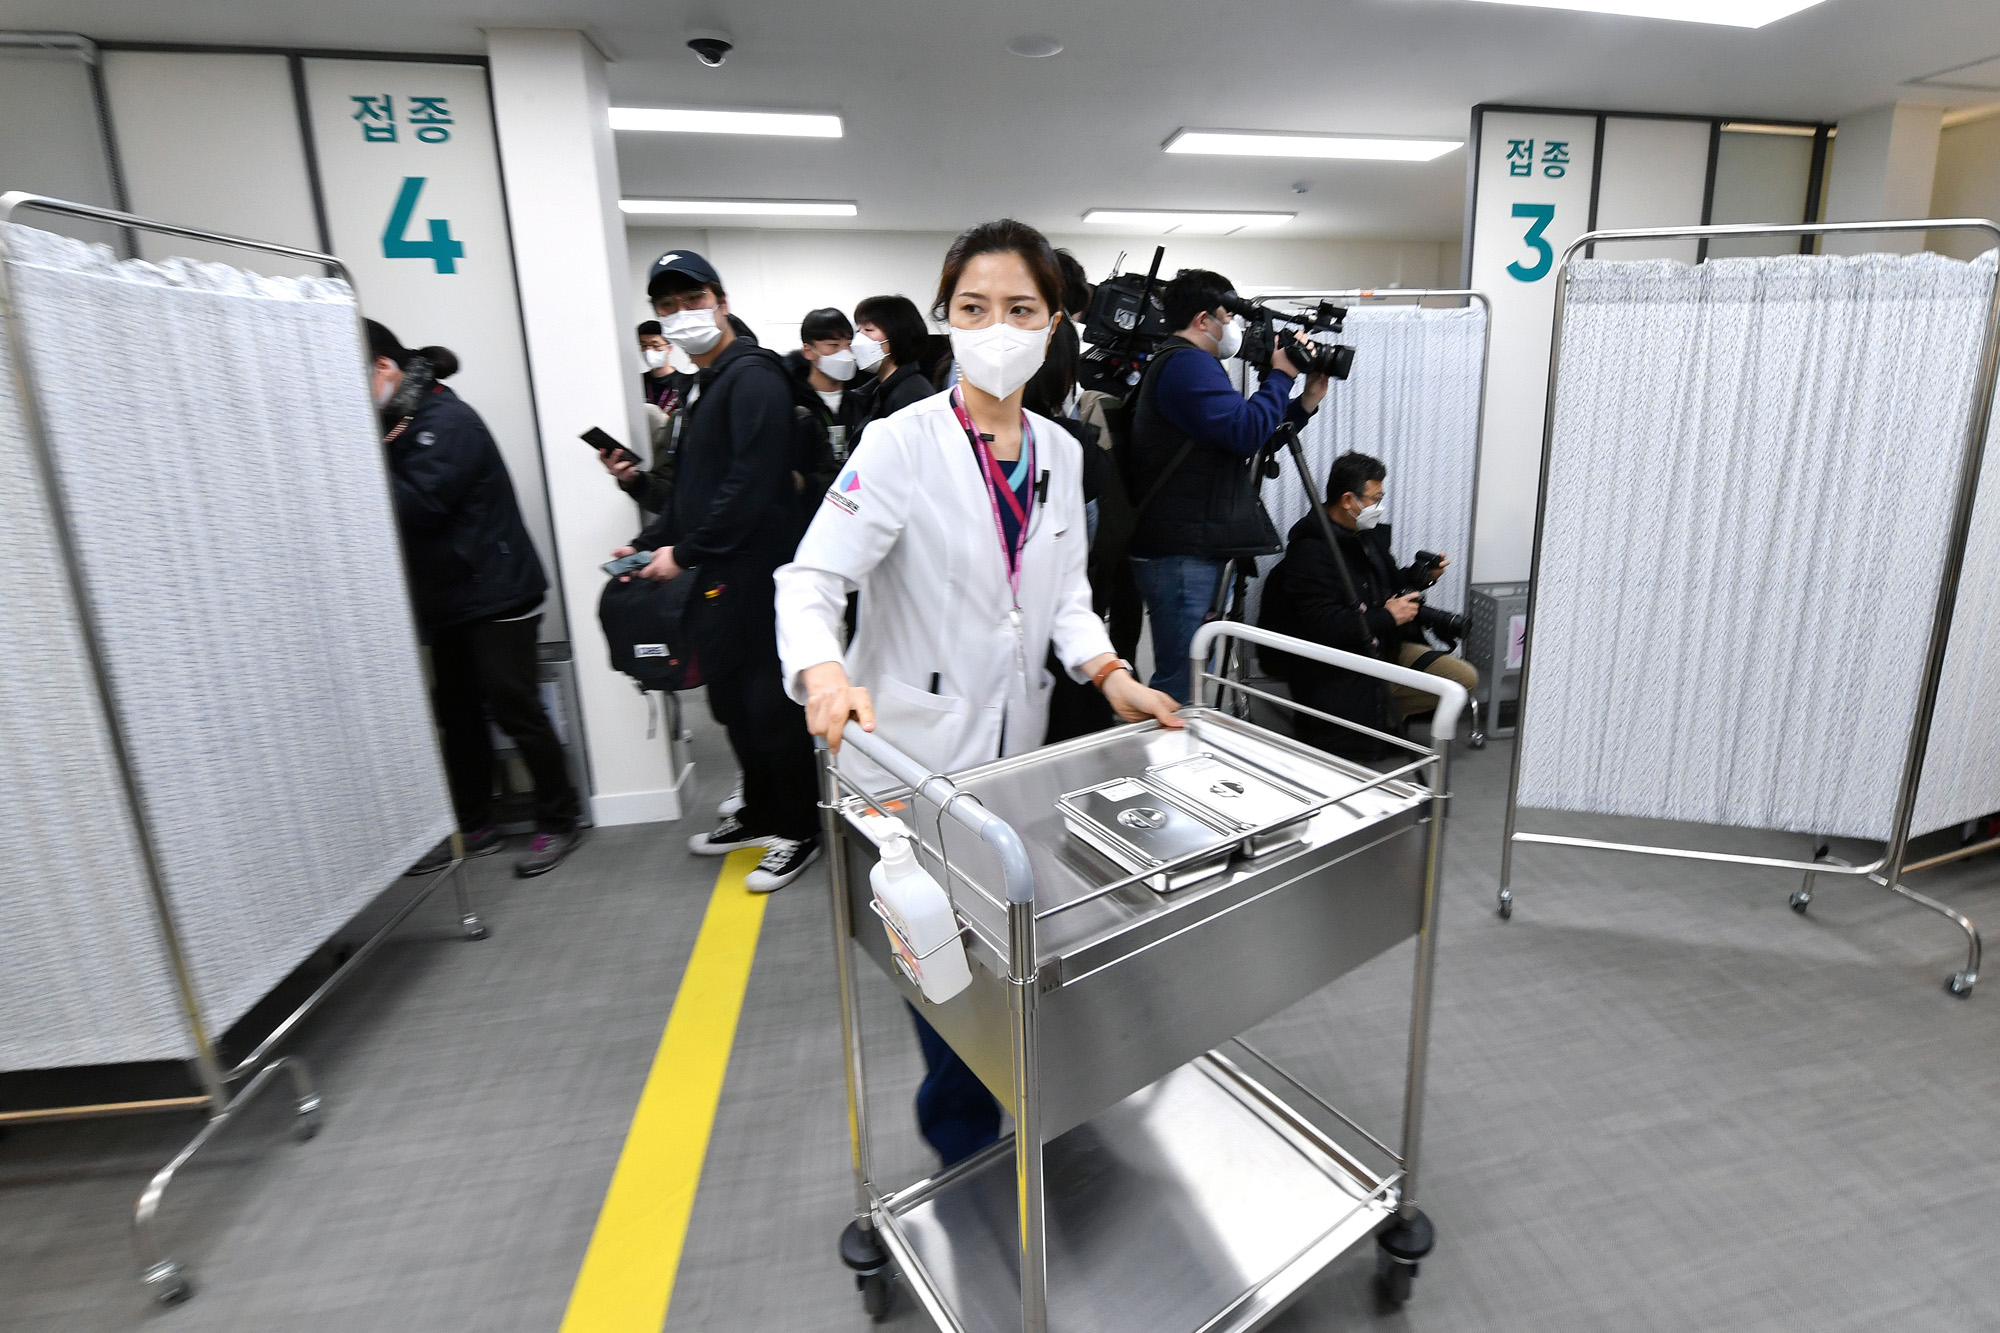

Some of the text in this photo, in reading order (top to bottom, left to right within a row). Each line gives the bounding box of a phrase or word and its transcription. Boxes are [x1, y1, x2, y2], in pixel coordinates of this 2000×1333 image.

[351, 94, 455, 144] 접종
[1506, 138, 1570, 178] 접종
[381, 176, 465, 275] 4
[1506, 202, 1556, 283] 3
